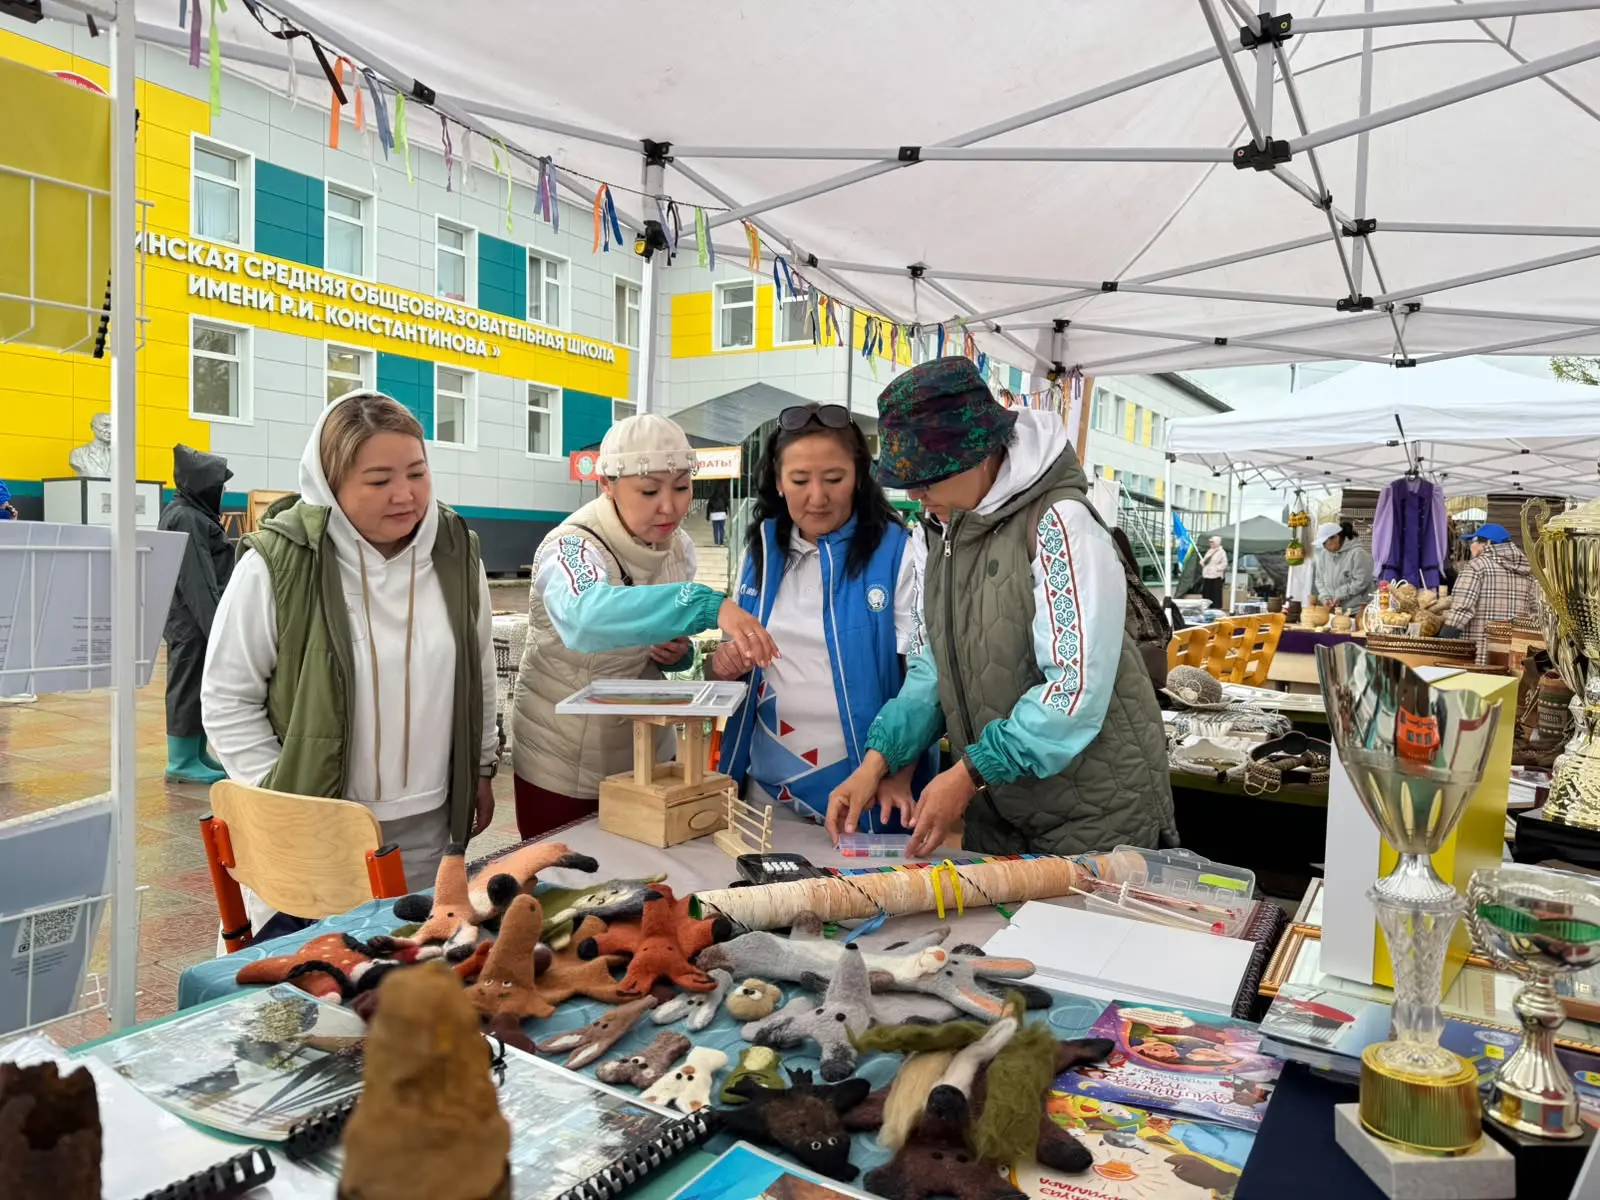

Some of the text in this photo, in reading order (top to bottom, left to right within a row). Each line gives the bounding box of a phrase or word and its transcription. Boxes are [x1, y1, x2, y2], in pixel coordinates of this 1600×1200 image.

[188, 273, 274, 312] ИМЕНИ
[280, 295, 320, 321] Р.И.
[325, 304, 488, 357] КОНСТАНТИНОВА
[244, 256, 347, 299] СРЕДНЯЯ
[350, 282, 564, 350] ОБЩЕОБРАЗОВАТЕЛЬНАЯ
[567, 337, 615, 362] ШКОЛА
[696, 459, 732, 469] ВАТЬ!
